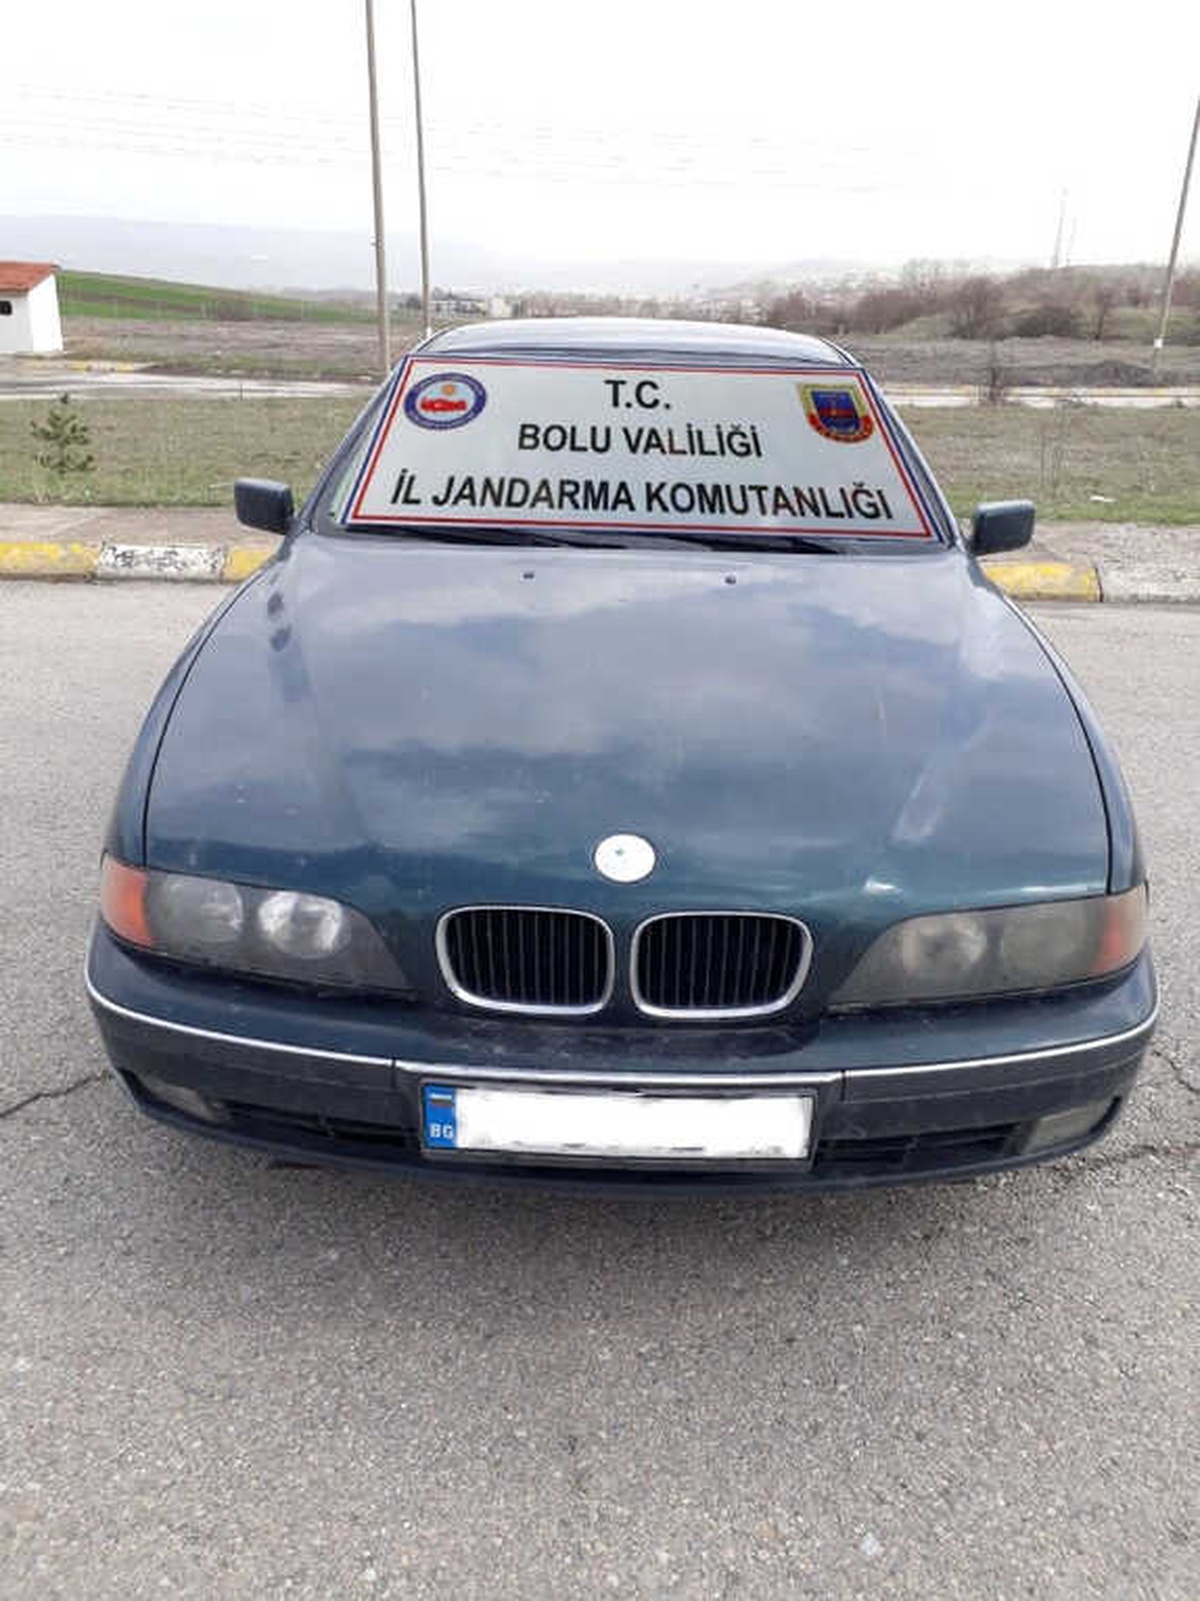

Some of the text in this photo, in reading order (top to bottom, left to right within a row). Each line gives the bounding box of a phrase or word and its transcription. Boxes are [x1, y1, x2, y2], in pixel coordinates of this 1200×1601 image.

[605, 379, 672, 410] T.C.
[517, 423, 763, 458] BOLU VALİLİĞİ
[390, 468, 894, 520] İL JANDARMA KOMUTANLIĞI
[430, 1123, 454, 1139] BG
